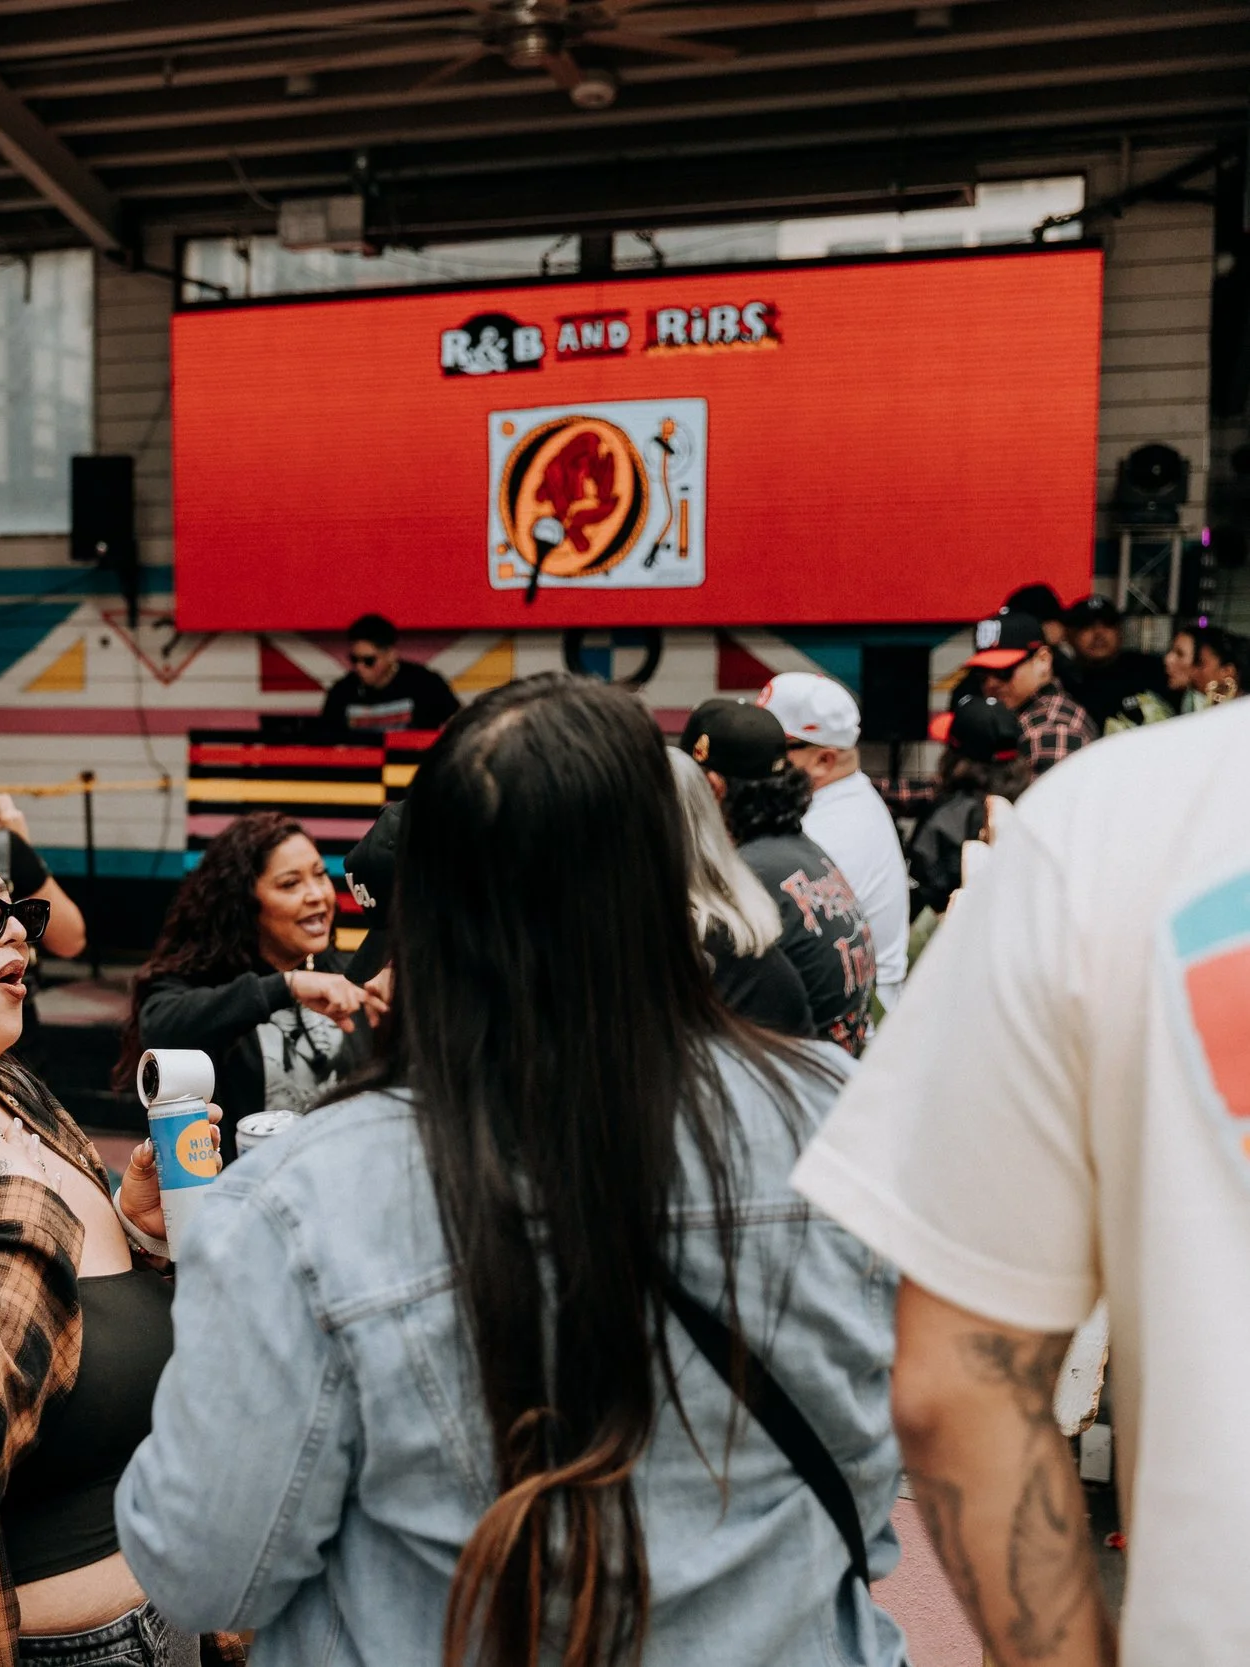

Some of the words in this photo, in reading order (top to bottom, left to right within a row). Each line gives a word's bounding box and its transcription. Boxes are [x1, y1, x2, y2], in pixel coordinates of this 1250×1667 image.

[441, 325, 544, 375] R&B
[557, 320, 630, 352] AND
[189, 1137, 213, 1150] HIG
[188, 1149, 215, 1162] NOO
